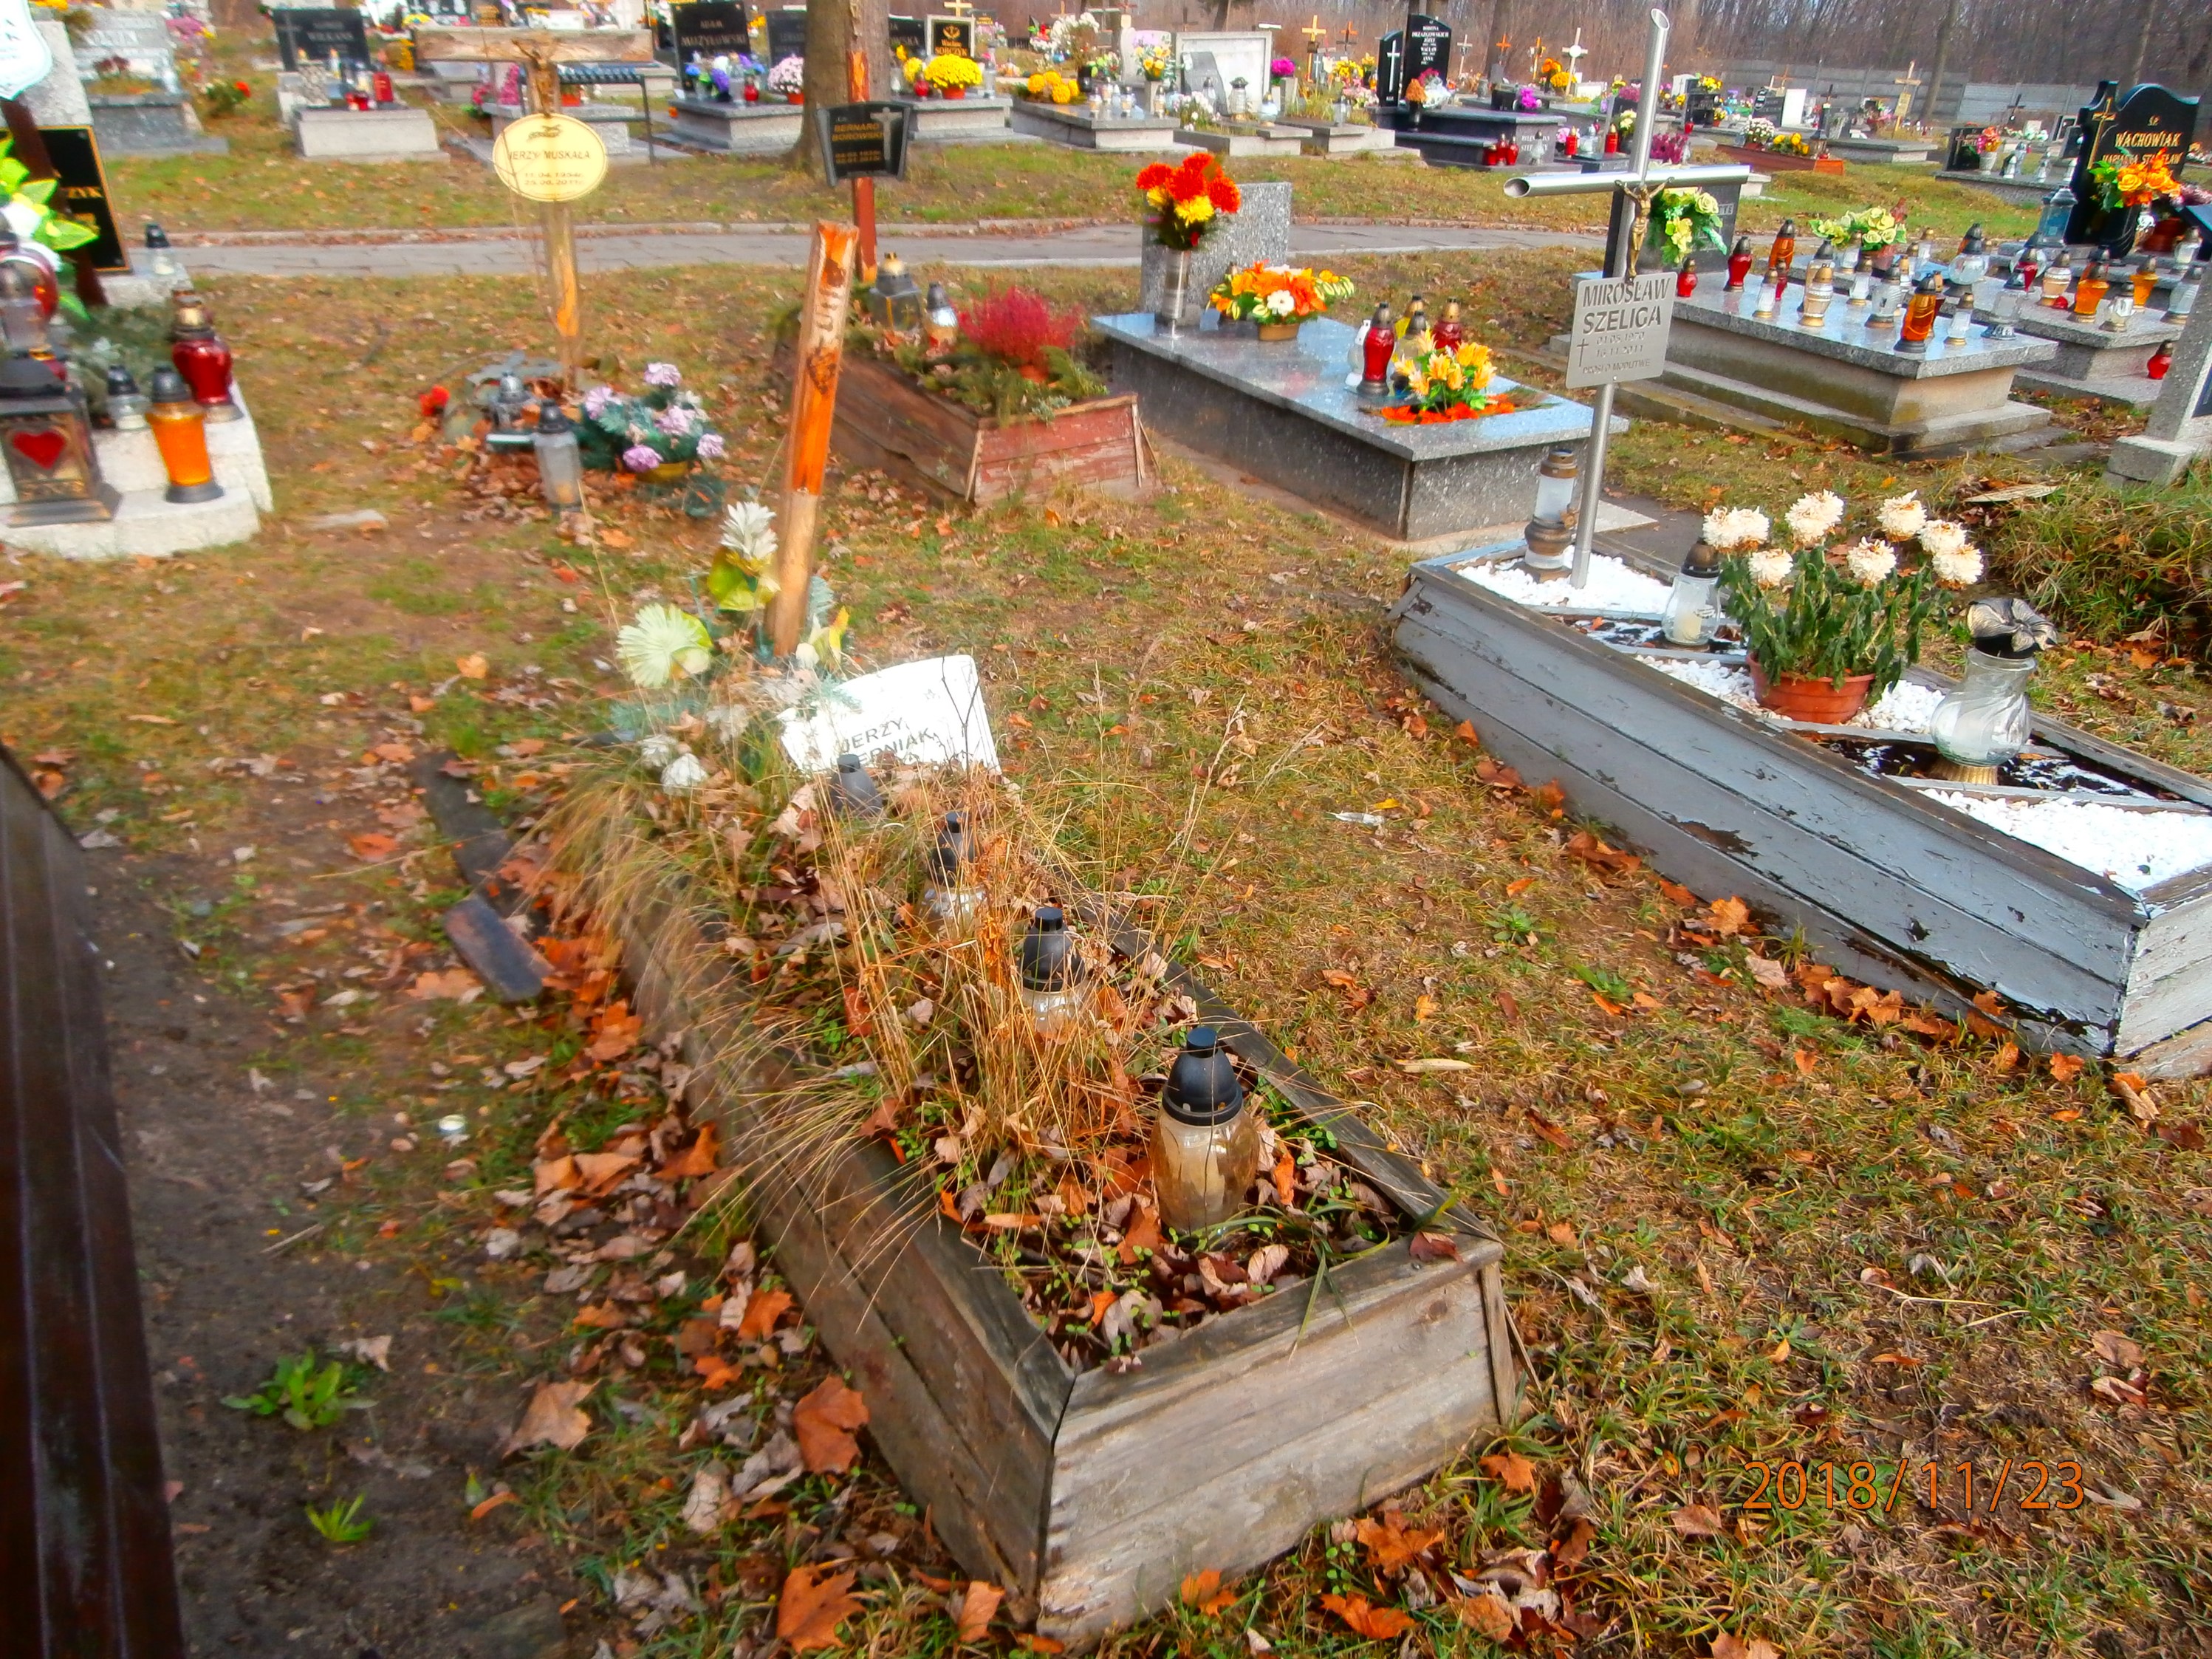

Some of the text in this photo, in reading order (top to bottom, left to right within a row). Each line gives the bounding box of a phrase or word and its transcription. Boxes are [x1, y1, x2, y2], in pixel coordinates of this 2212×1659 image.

[832, 131, 883, 142] BOROWSKI
[2115, 130, 2182, 147] WACHOWIAK
[544, 150, 590, 160] MUSKAŁA
[1583, 278, 1671, 307] MIROSŁAW
[1583, 306, 1661, 334] SZELIGA
[842, 716, 903, 754] JERZY
